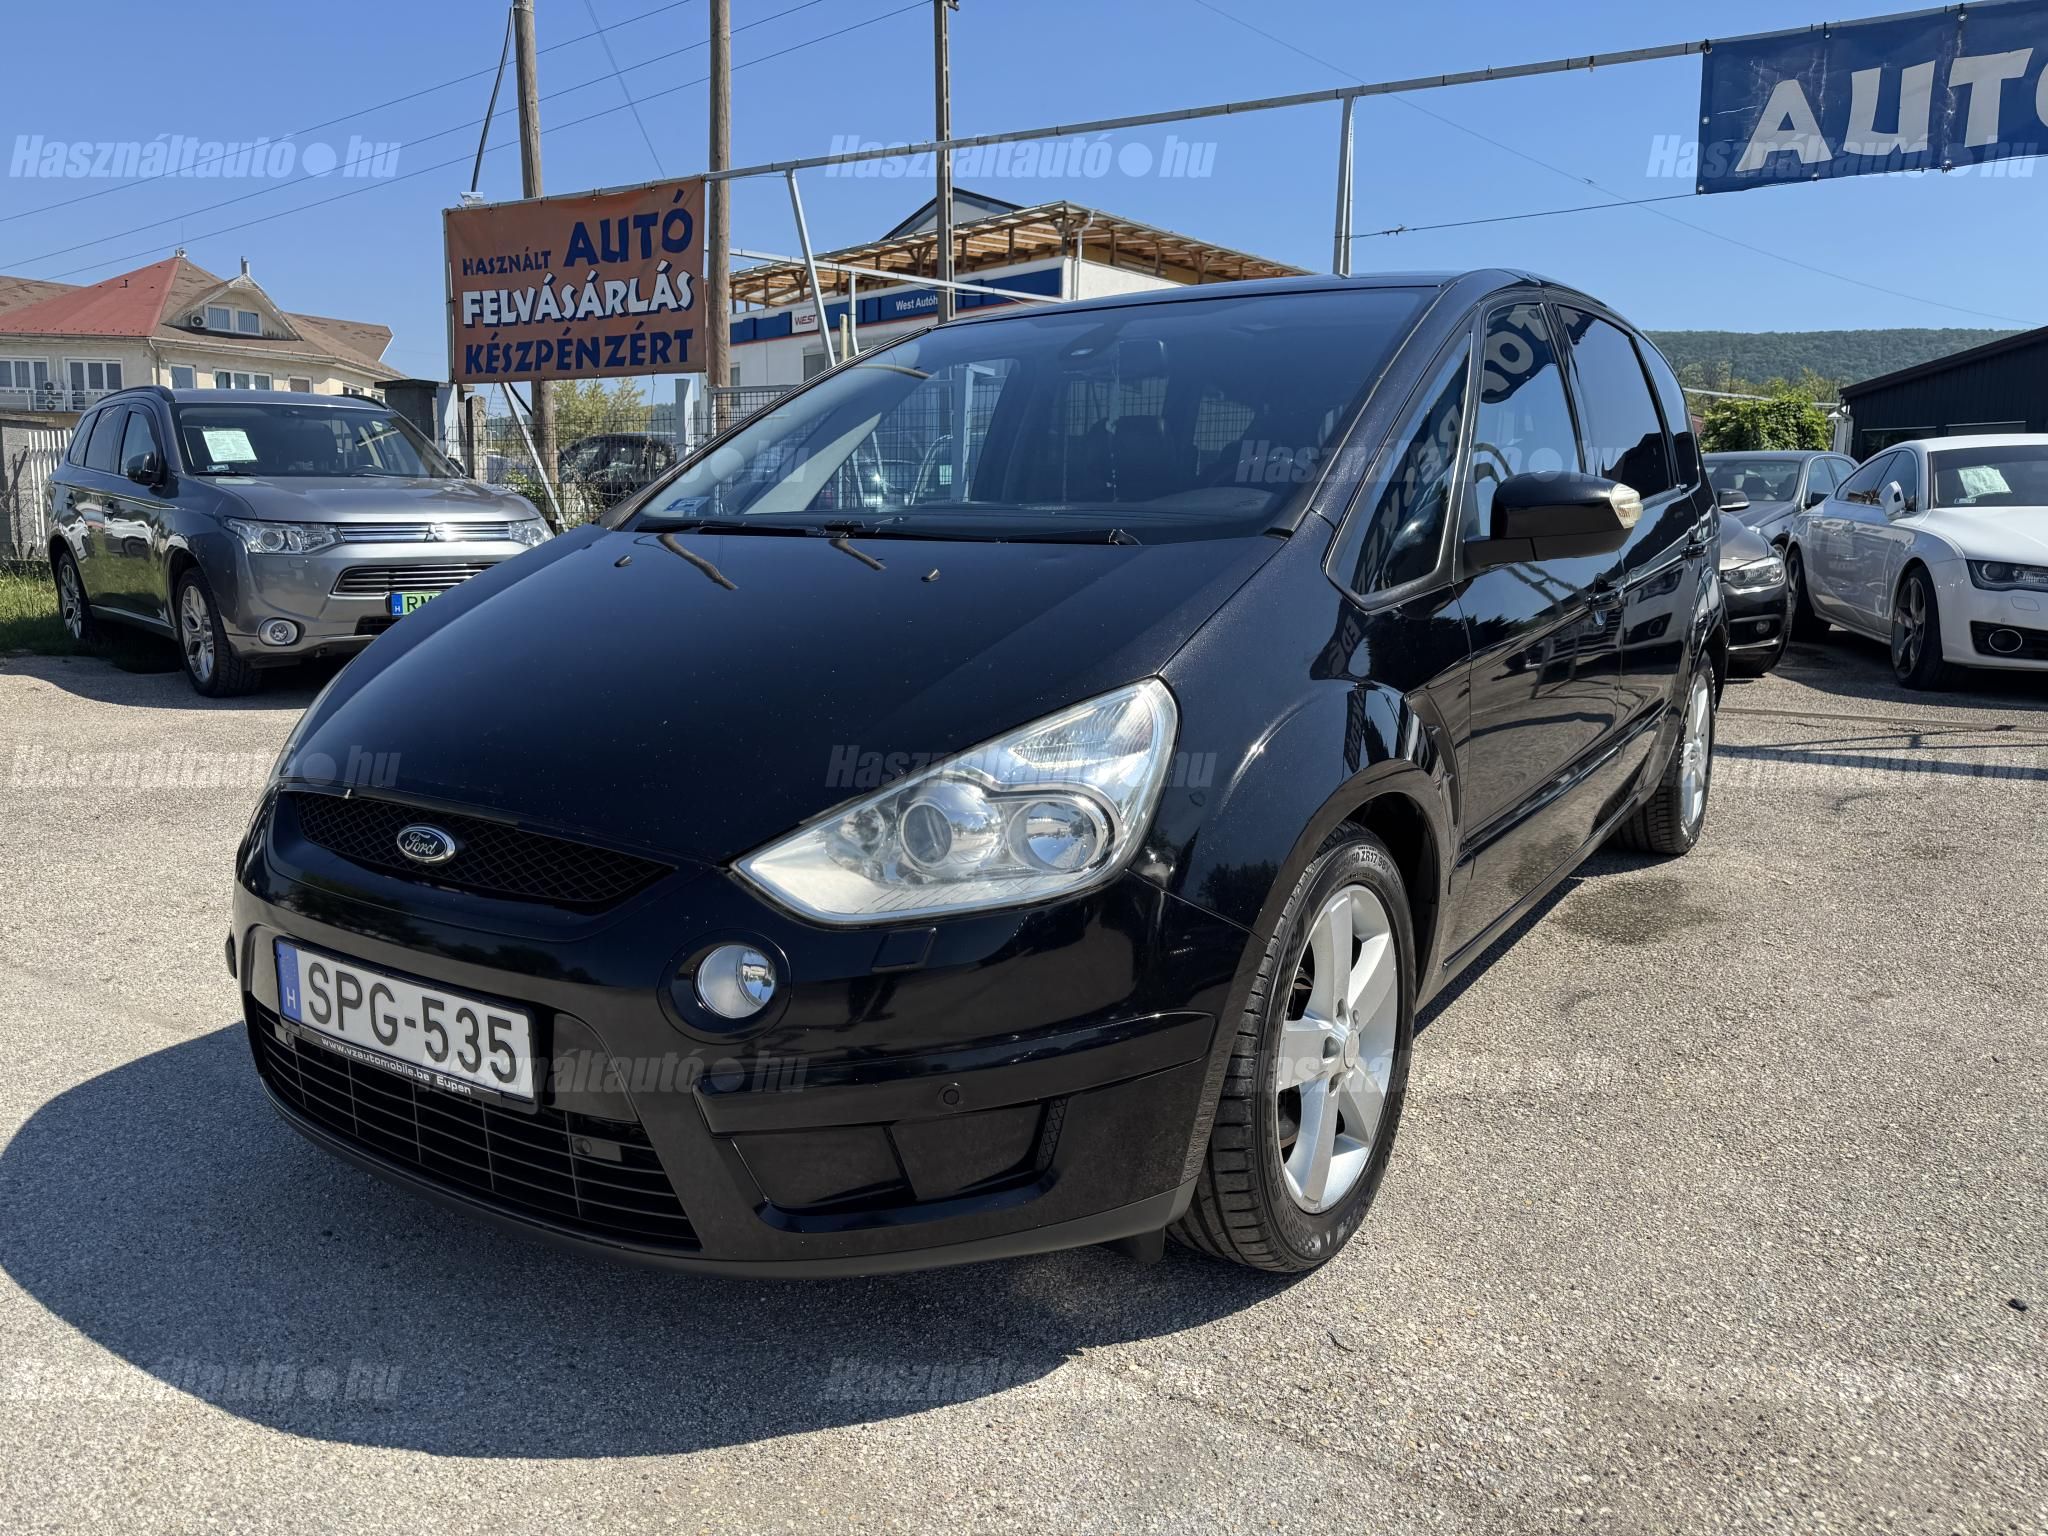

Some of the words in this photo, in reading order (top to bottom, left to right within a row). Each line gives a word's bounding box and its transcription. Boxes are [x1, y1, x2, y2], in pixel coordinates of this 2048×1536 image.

[1735, 47, 2048, 172] AUT
[462, 247, 551, 276] HASZNÁLT
[563, 189, 693, 267] AUTÓ
[462, 259, 695, 328] FELVÁSÁRLÁS
[794, 314, 816, 326] WEST
[896, 299, 914, 311] West
[465, 321, 694, 374] KÉSZPÉNZÉRT
[394, 605, 401, 613] H
[405, 831, 438, 855] Ford
[285, 987, 297, 1010] H
[308, 961, 517, 1084] SPG-535
[321, 1037, 430, 1082] www.vzautomobile.be
[436, 1075, 472, 1095] Eupen
